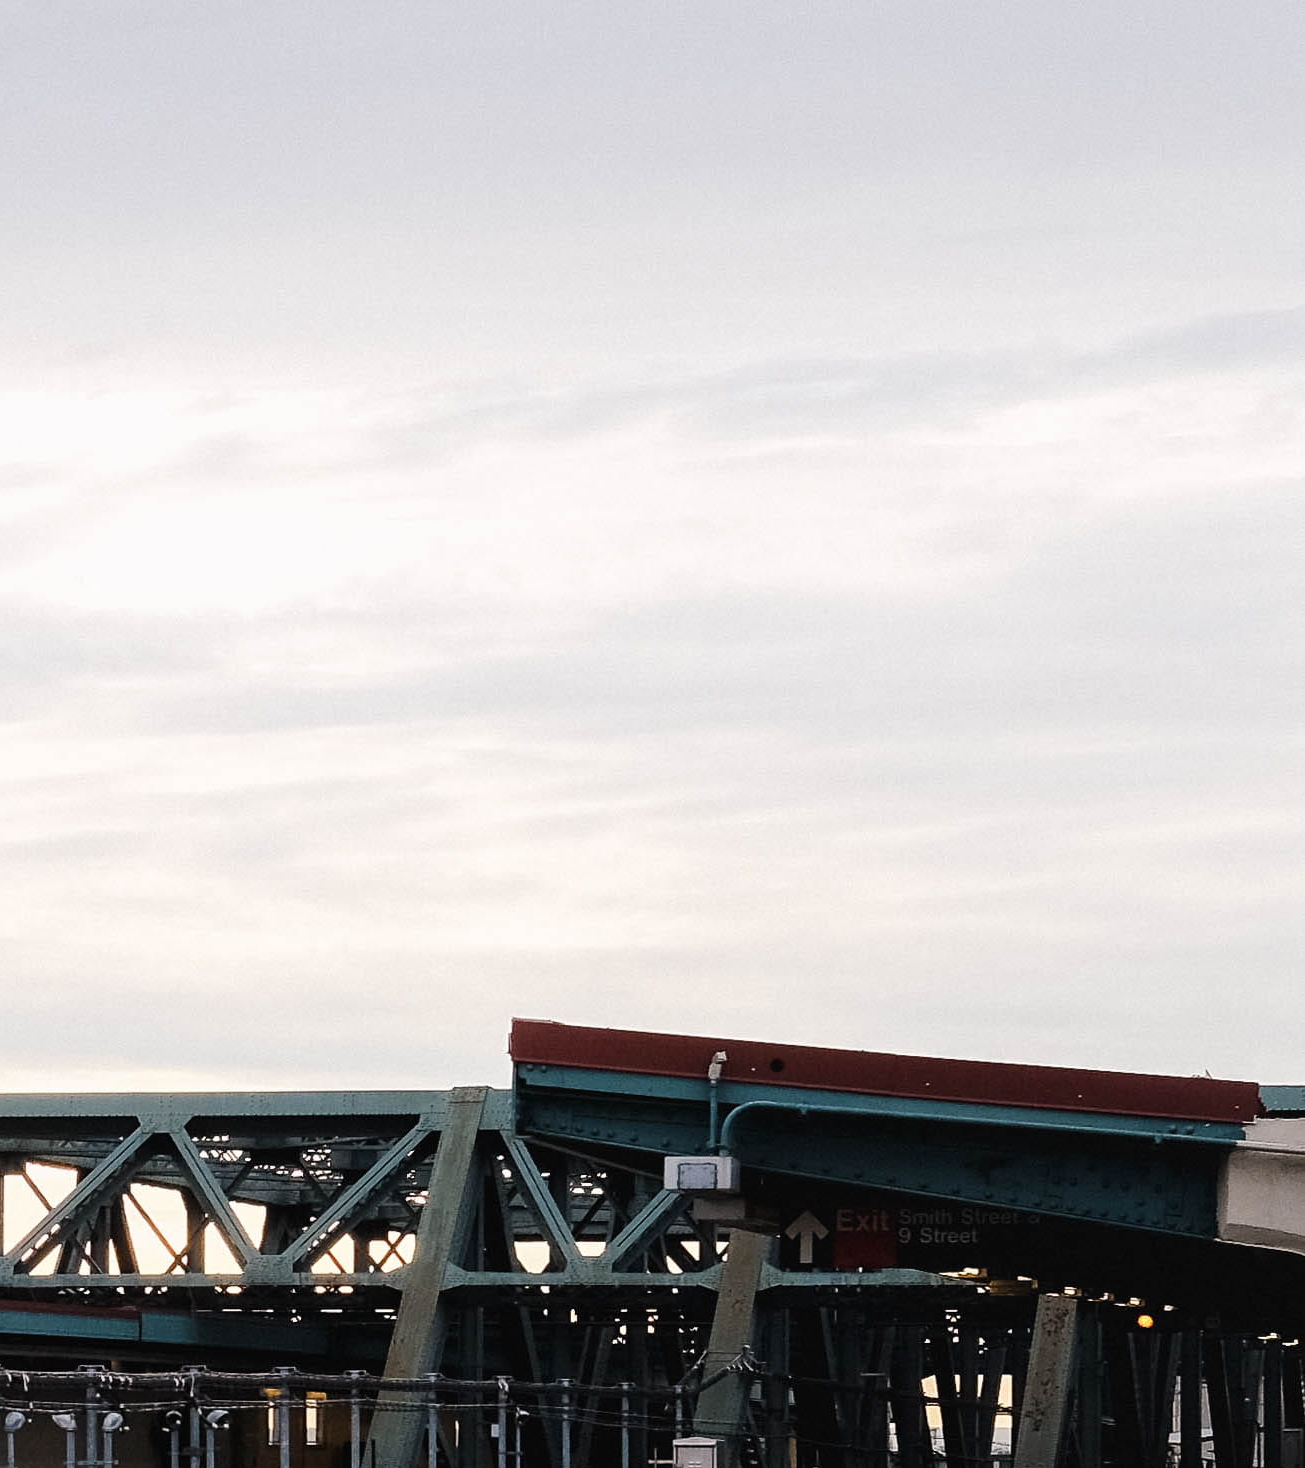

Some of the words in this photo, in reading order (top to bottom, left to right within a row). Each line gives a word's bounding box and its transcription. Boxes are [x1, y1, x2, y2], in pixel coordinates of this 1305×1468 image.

[836, 1208, 890, 1232] Exit
[897, 1208, 952, 1225] Smith
[961, 1208, 1021, 1225] Street
[897, 1227, 911, 1244] 9
[919, 1226, 979, 1244] Street
